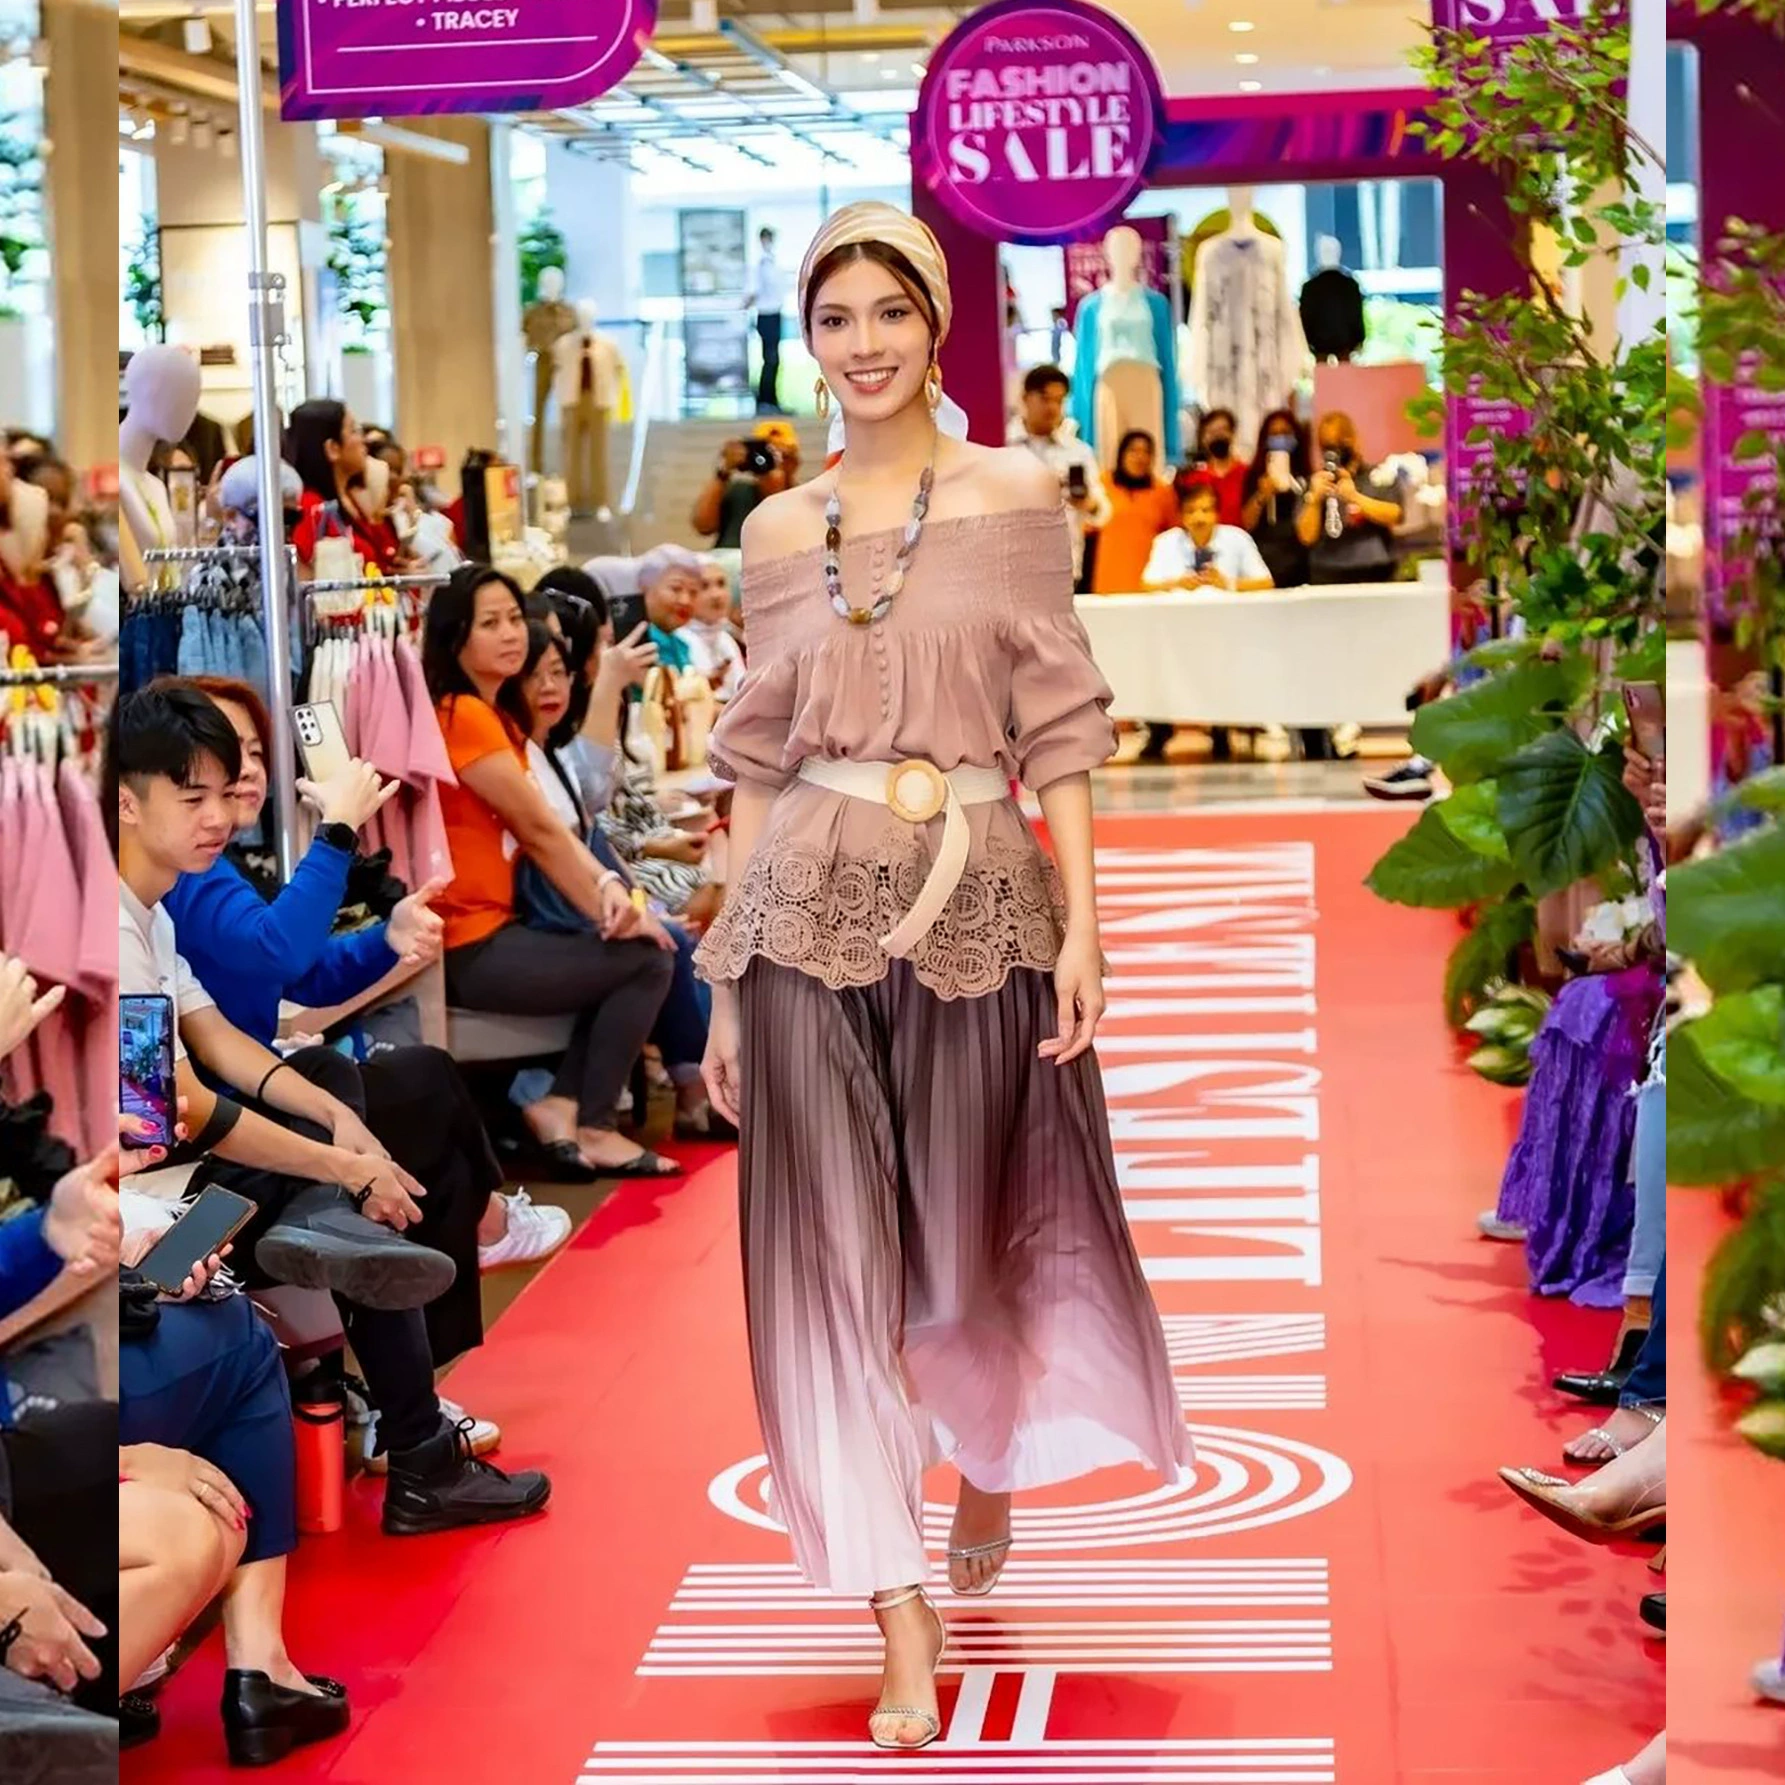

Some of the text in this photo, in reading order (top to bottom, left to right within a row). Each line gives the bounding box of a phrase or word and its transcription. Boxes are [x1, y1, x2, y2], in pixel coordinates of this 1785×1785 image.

[431, 9, 519, 31] TRACEY
[985, 35, 1090, 53] PARKSON
[948, 62, 1130, 99] FASHION
[949, 95, 1130, 131] LIFESTYLE
[949, 125, 1135, 185] SALE
